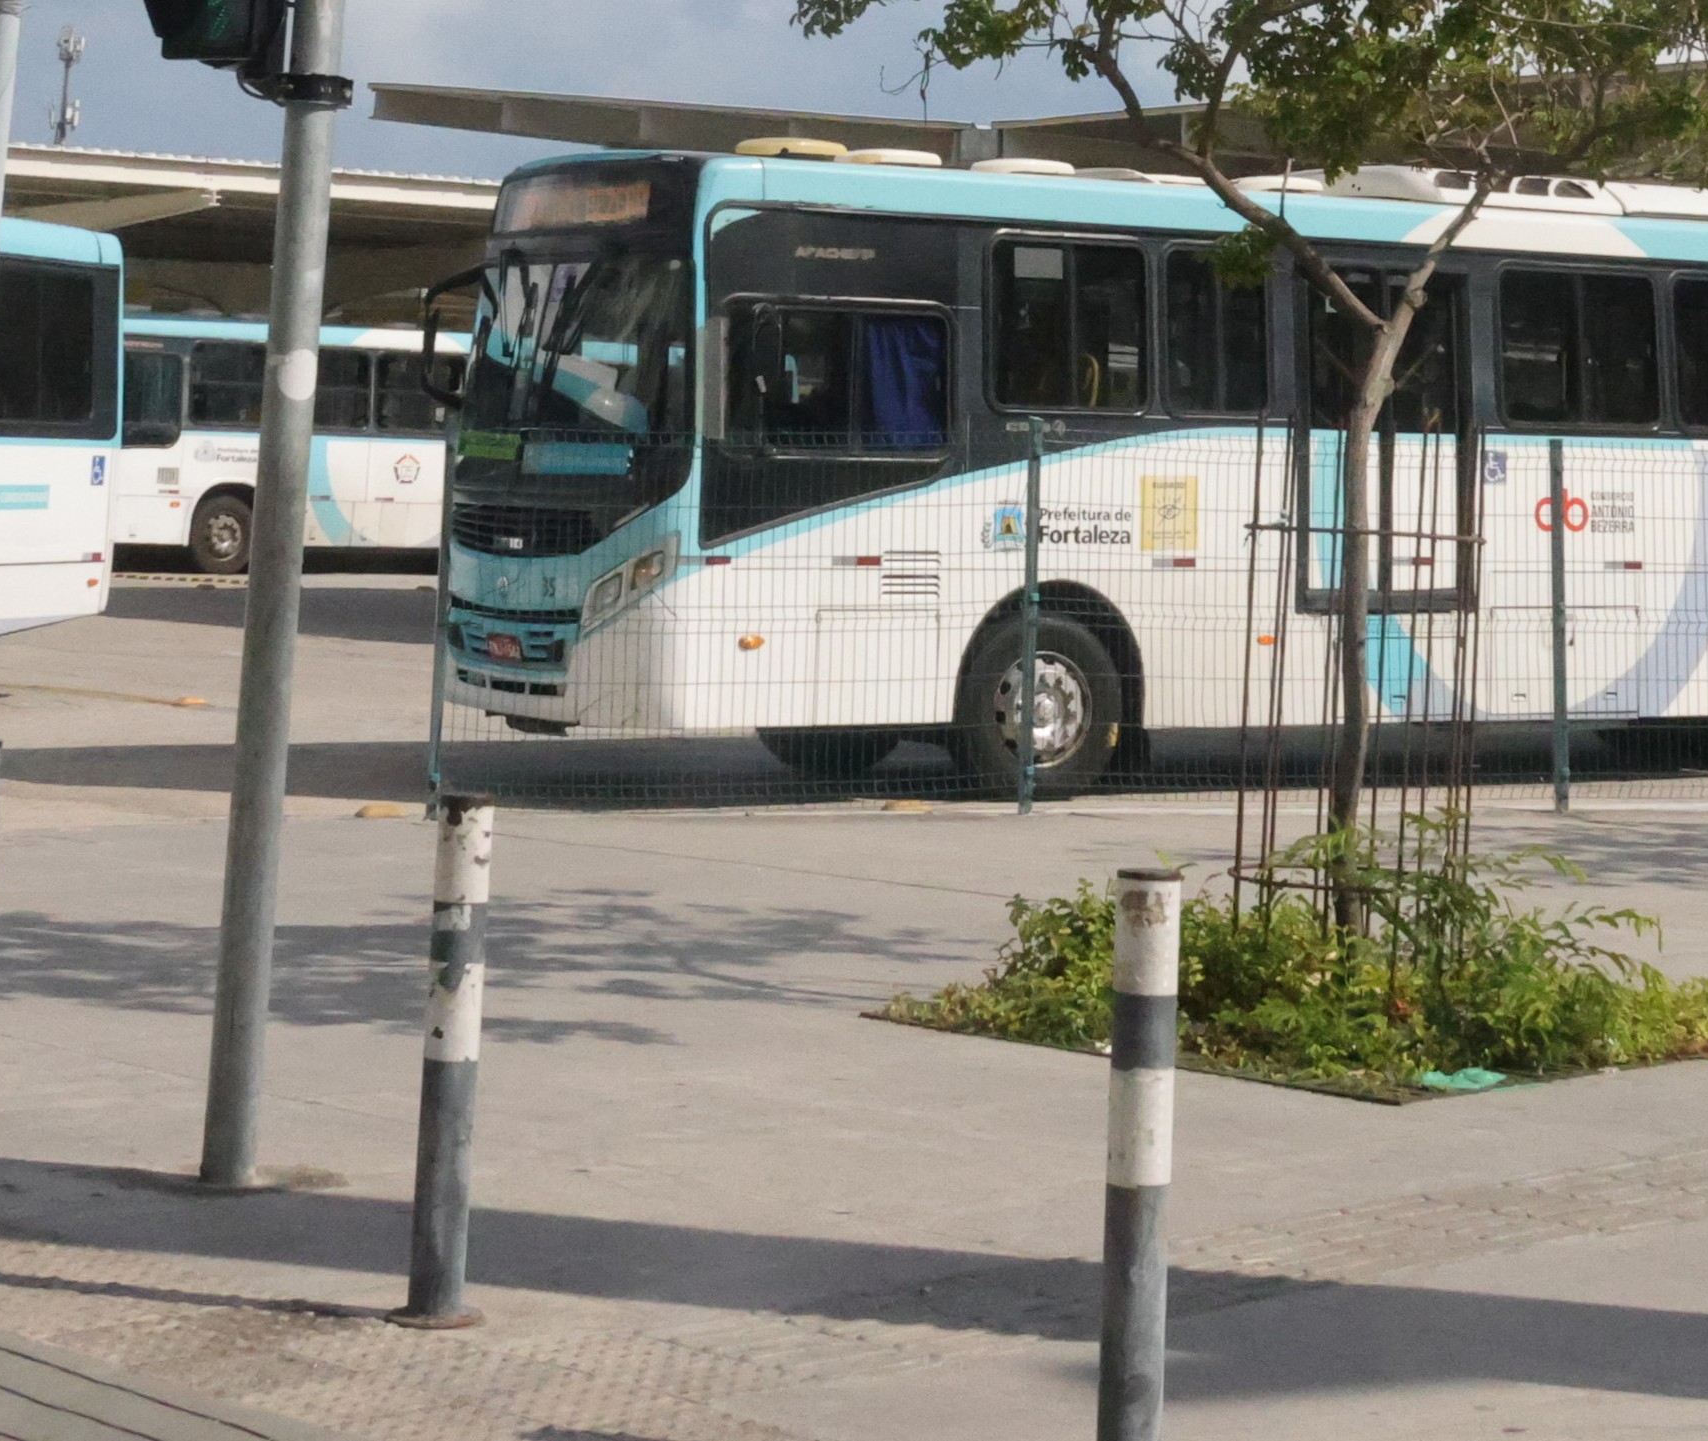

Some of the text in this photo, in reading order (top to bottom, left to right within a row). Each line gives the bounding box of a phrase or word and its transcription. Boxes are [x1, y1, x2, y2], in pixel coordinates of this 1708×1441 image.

[1039, 508, 1131, 521] Prefeitura de
[1591, 520, 1634, 533] BEZERRA
[1039, 524, 1131, 544] Fortaleza
